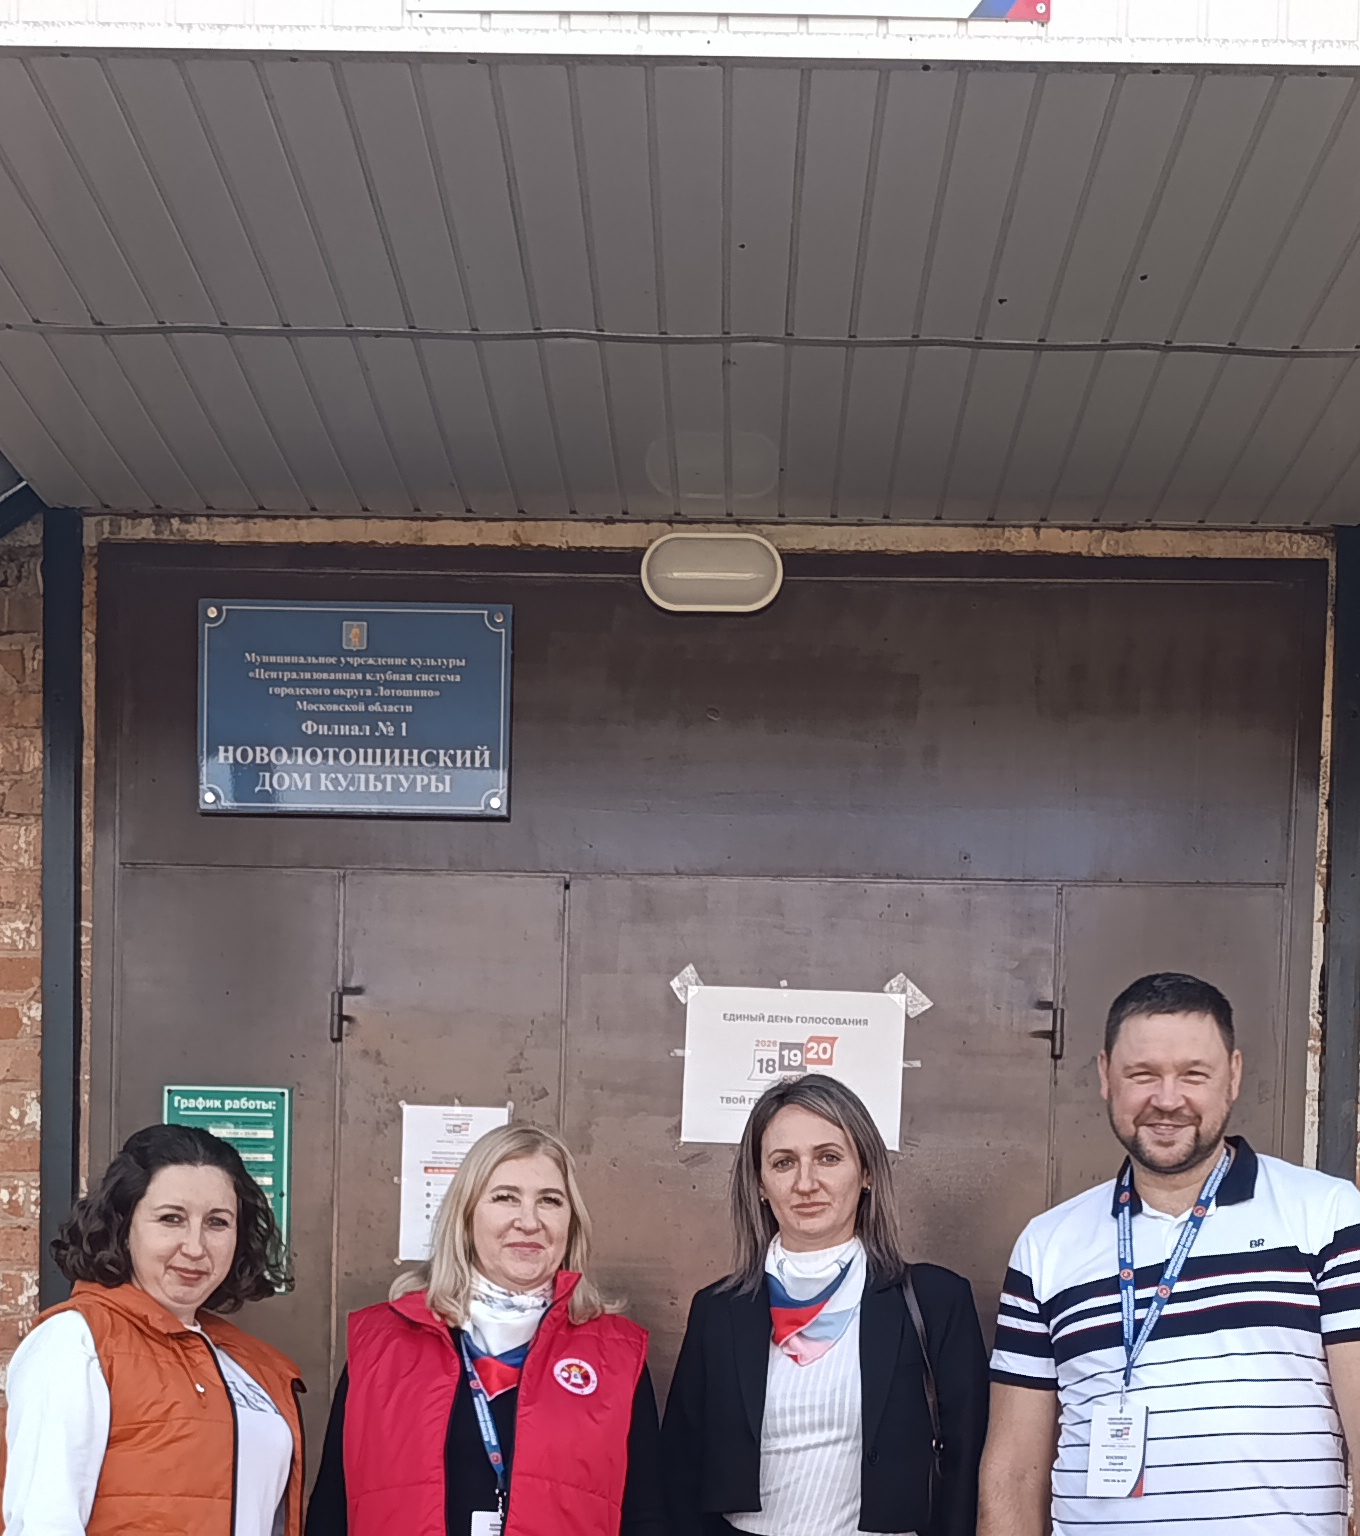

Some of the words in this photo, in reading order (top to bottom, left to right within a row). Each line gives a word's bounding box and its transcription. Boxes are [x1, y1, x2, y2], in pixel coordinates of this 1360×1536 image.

[244, 652, 338, 666] Муниципальное
[340, 656, 408, 667] учреждение
[410, 658, 466, 669] культуры
[366, 671, 413, 683] клубная
[415, 674, 461, 682] система
[268, 687, 330, 697] городского
[333, 688, 372, 699] округа
[296, 701, 365, 712] Московской
[368, 702, 413, 713] области
[301, 720, 370, 736] Филиал
[375, 721, 395, 737] №
[401, 722, 408, 737] 1
[217, 745, 491, 768] НОВОЛОТОШИНСКИЙ
[255, 772, 311, 793] ДОМ
[320, 773, 452, 793] КУЛЬТУРЫ
[723, 1013, 765, 1022] ЕДИНЫЙ
[767, 1015, 793, 1024] ДЕНЬ
[796, 1016, 869, 1026] ГОЛОСОВАНИЯ
[757, 1058, 777, 1074] 18
[782, 1049, 802, 1066] 19
[807, 1043, 831, 1059] 20
[174, 1096, 222, 1110] График
[224, 1097, 276, 1110] работы:
[720, 1096, 746, 1104] ТВОЙ
